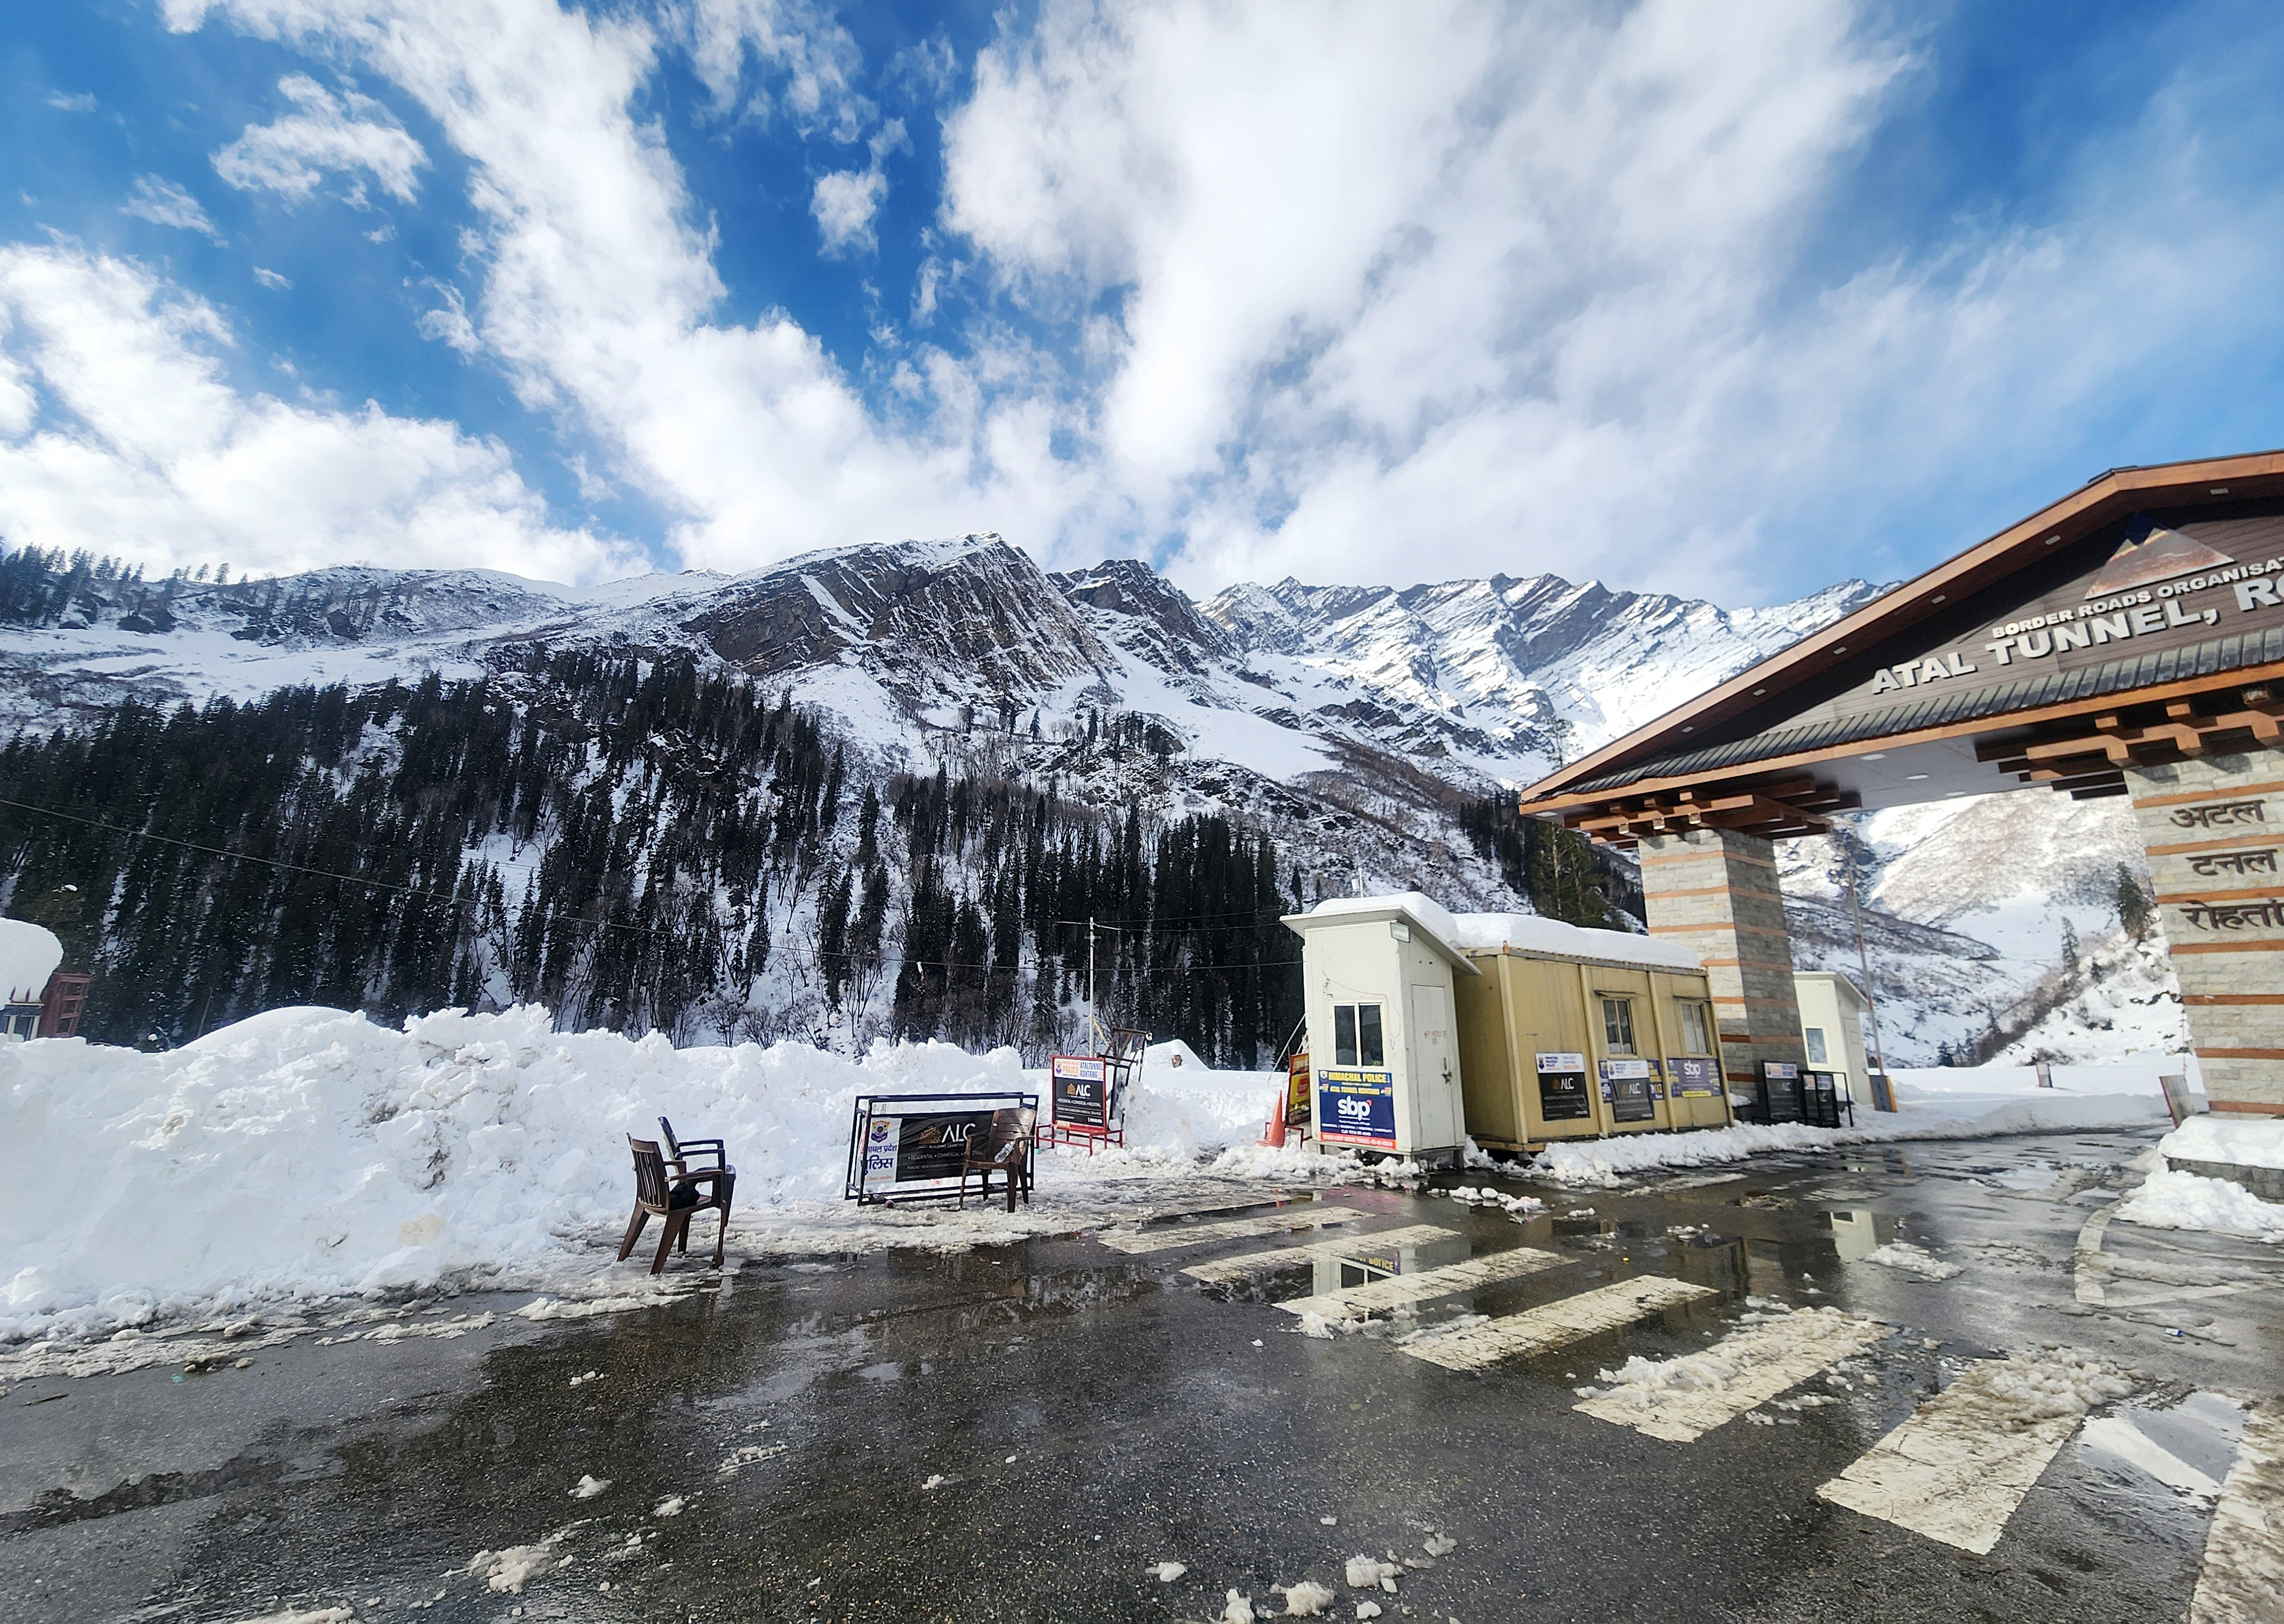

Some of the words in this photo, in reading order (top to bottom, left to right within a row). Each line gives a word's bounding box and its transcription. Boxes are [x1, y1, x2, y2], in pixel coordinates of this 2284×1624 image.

[1992, 609, 2074, 638] BORDER
[2078, 590, 2152, 617] ROADS
[1872, 652, 1977, 695] ATAL
[1985, 599, 2219, 665] TUNNEL,
[2170, 799, 2267, 828] अटल
[2185, 848, 2279, 876] टनल
[1063, 1065, 1079, 1074] POLICE
[1328, 1071, 1362, 1082] HIMACHAL
[1362, 1073, 1387, 1083] POLICE
[1684, 1060, 1701, 1078] sbp
[1075, 1084, 1091, 1097] ALC
[1561, 1077, 1575, 1090] ALC
[1628, 1083, 1641, 1094] ALC
[1337, 1095, 1370, 1121] sbp
[942, 1123, 976, 1143] ALC
[884, 1143, 897, 1153] प्रदेश
